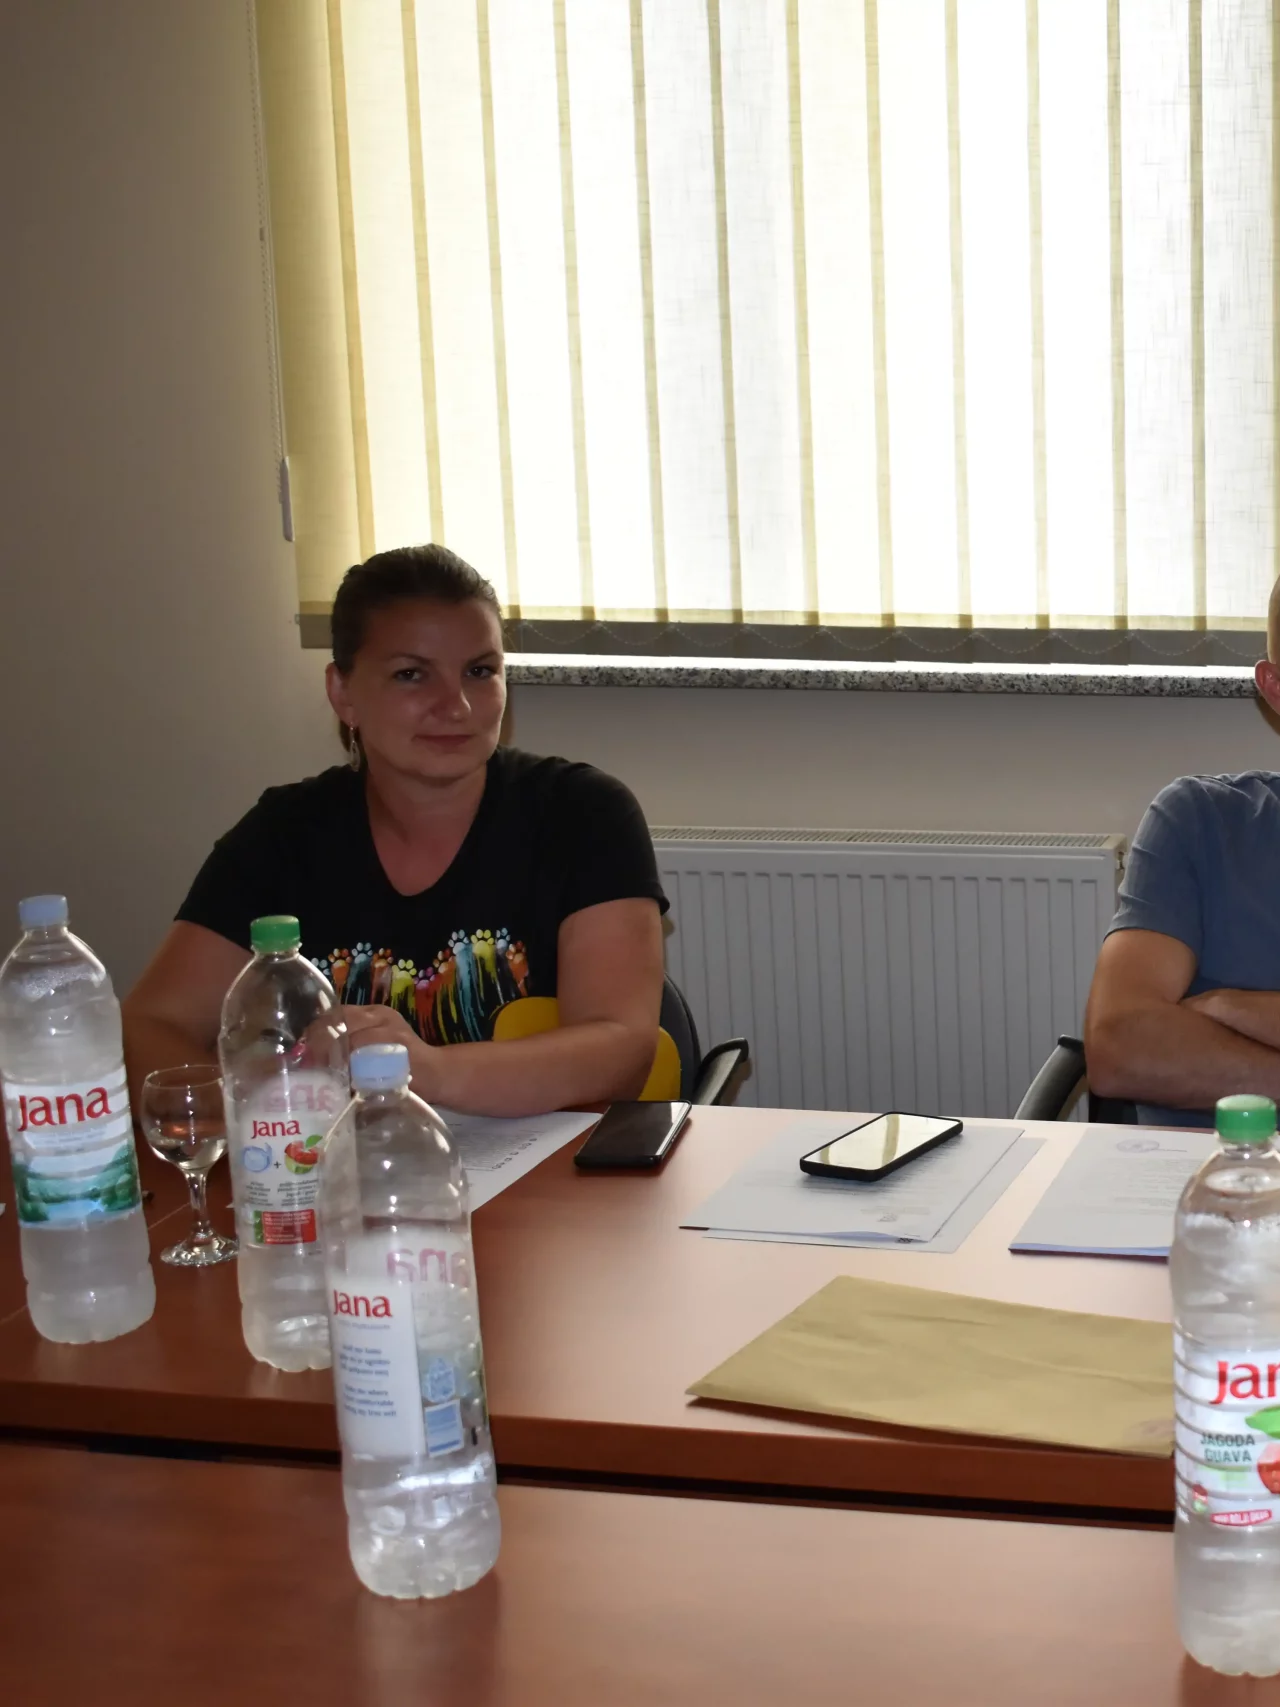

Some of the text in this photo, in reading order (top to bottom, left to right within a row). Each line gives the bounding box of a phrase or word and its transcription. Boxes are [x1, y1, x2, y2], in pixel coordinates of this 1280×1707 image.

[17, 1086, 112, 1132] Jana
[251, 1119, 302, 1140] Jana
[333, 1290, 393, 1318] Jana
[1200, 1432, 1255, 1447] JAGODA
[1204, 1448, 1252, 1463] GUAVA
